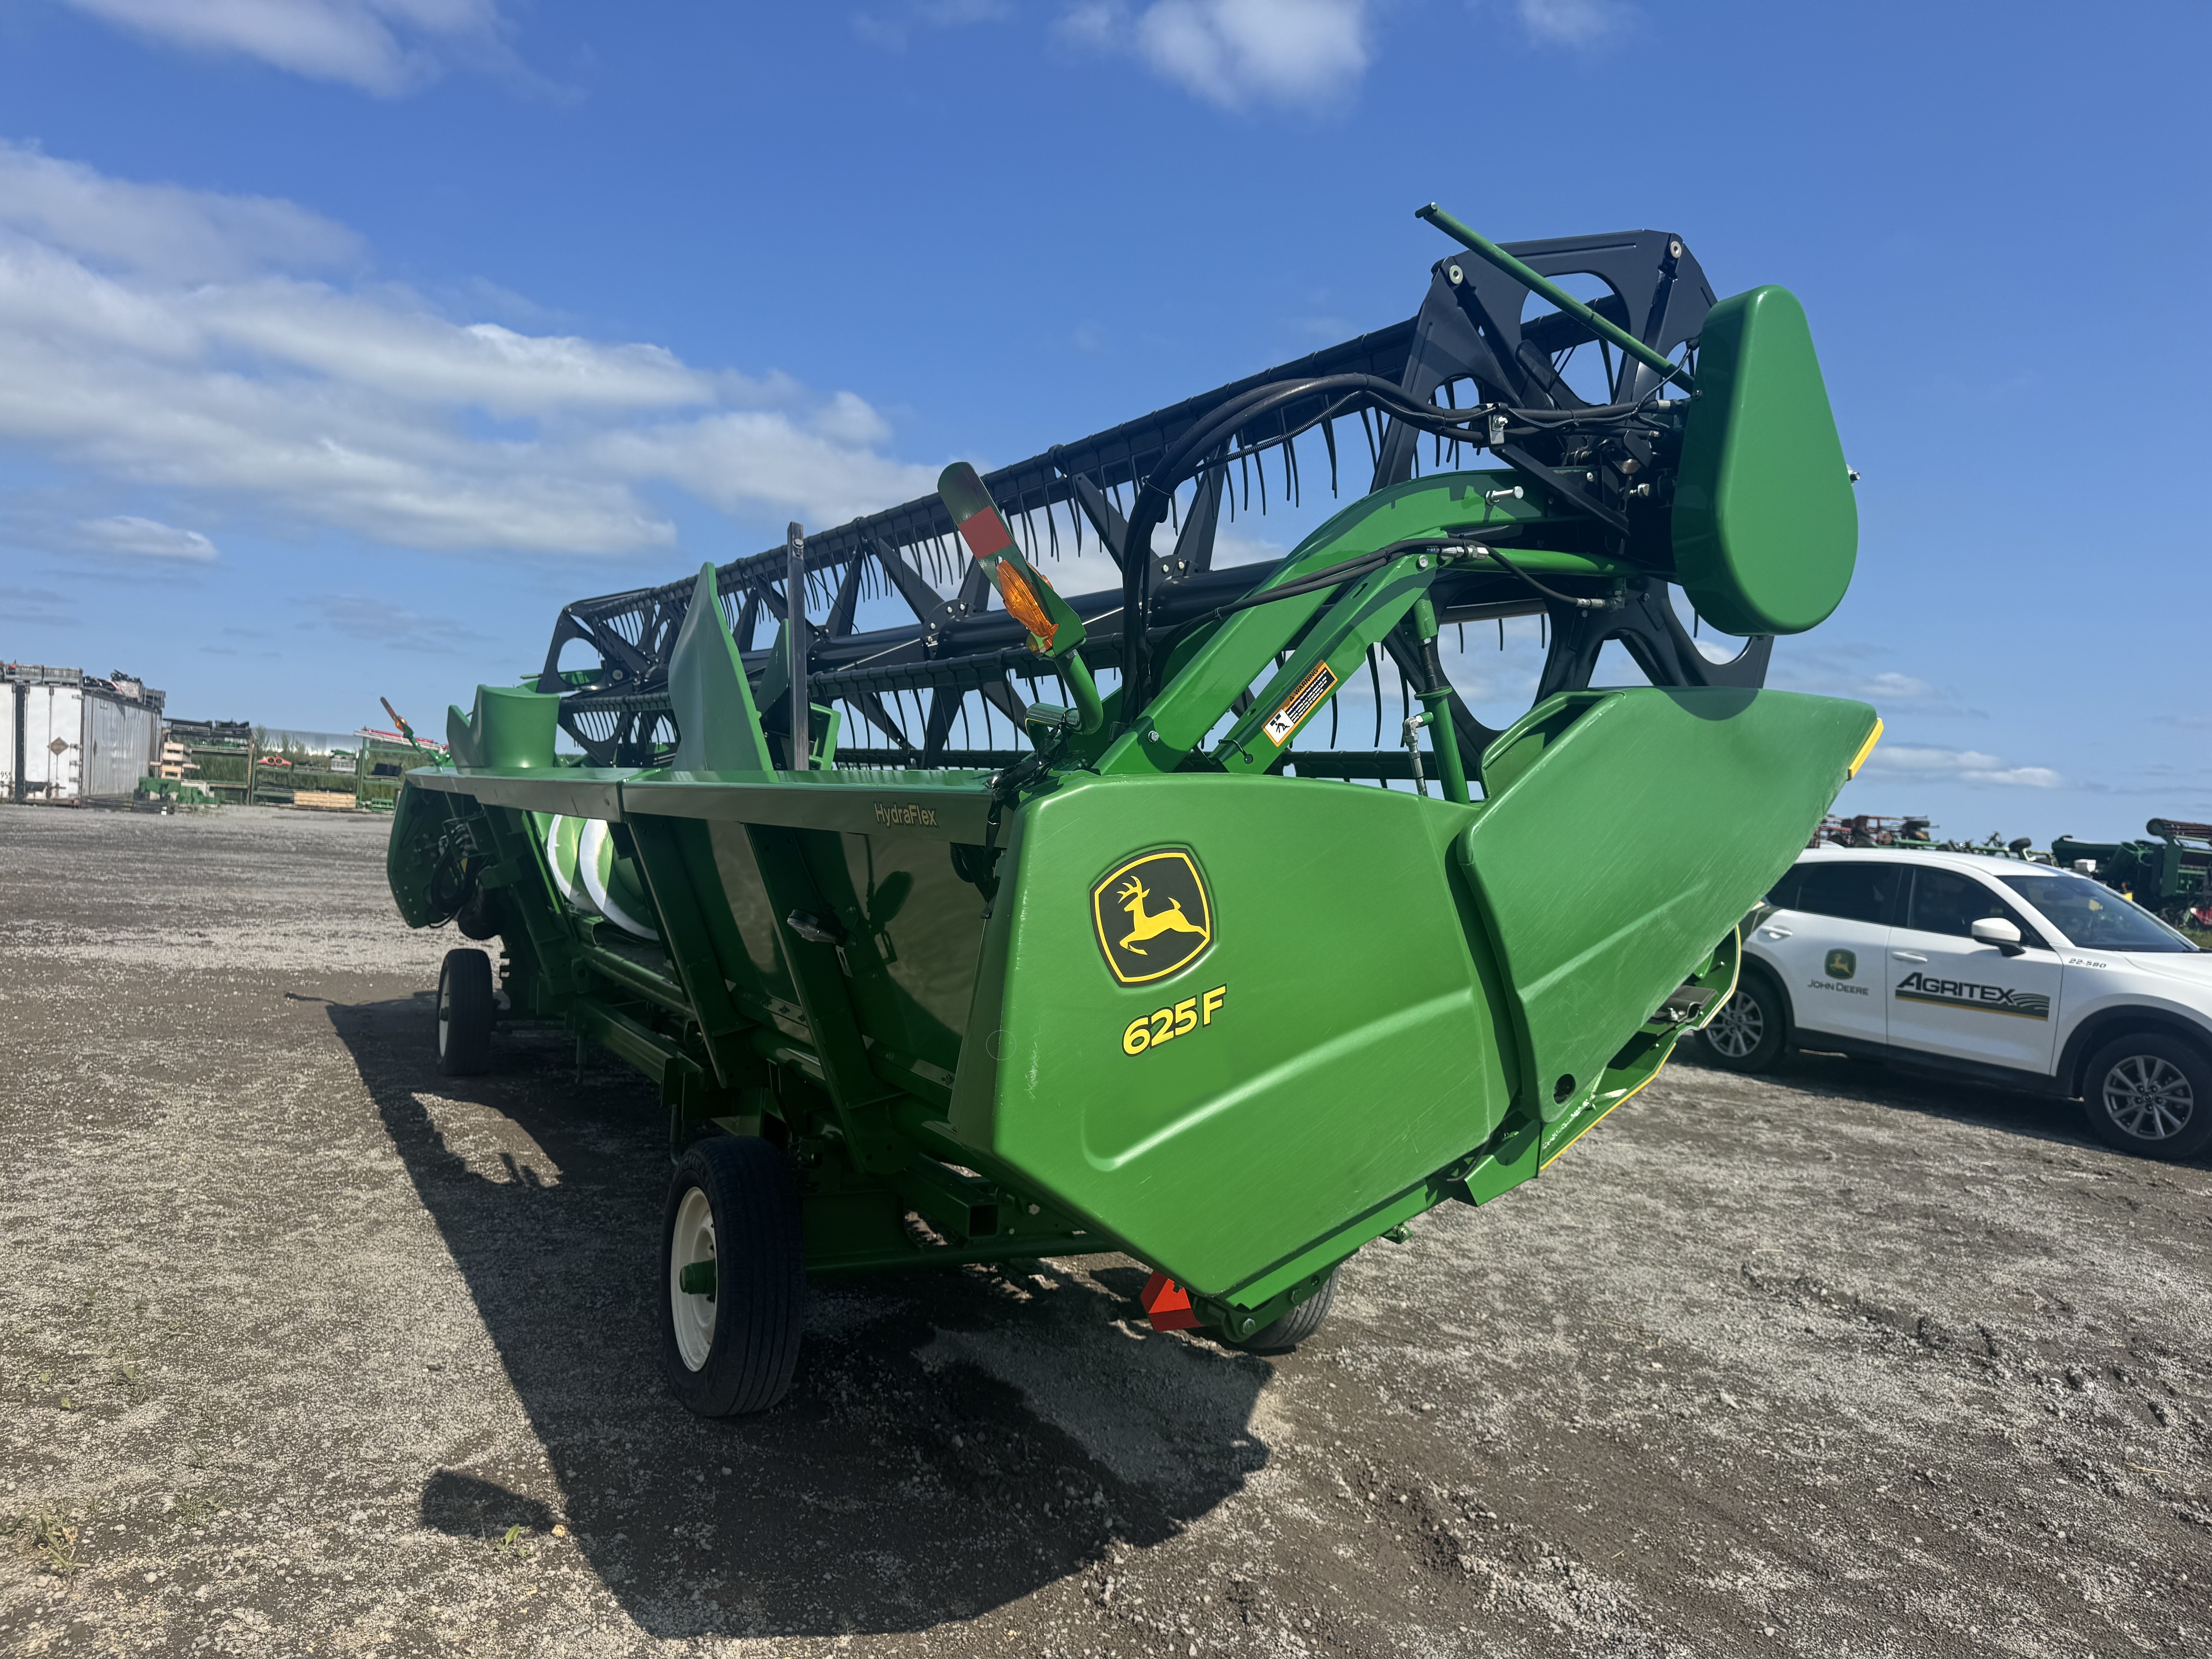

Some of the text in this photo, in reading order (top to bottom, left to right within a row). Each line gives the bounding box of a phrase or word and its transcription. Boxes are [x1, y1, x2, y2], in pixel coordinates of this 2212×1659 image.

[1294, 668, 1318, 695] WARNING
[874, 802, 938, 827] HydraFlex
[1807, 979, 1869, 996] JOHN DEERE
[1897, 971, 2016, 1004] AGRITEX
